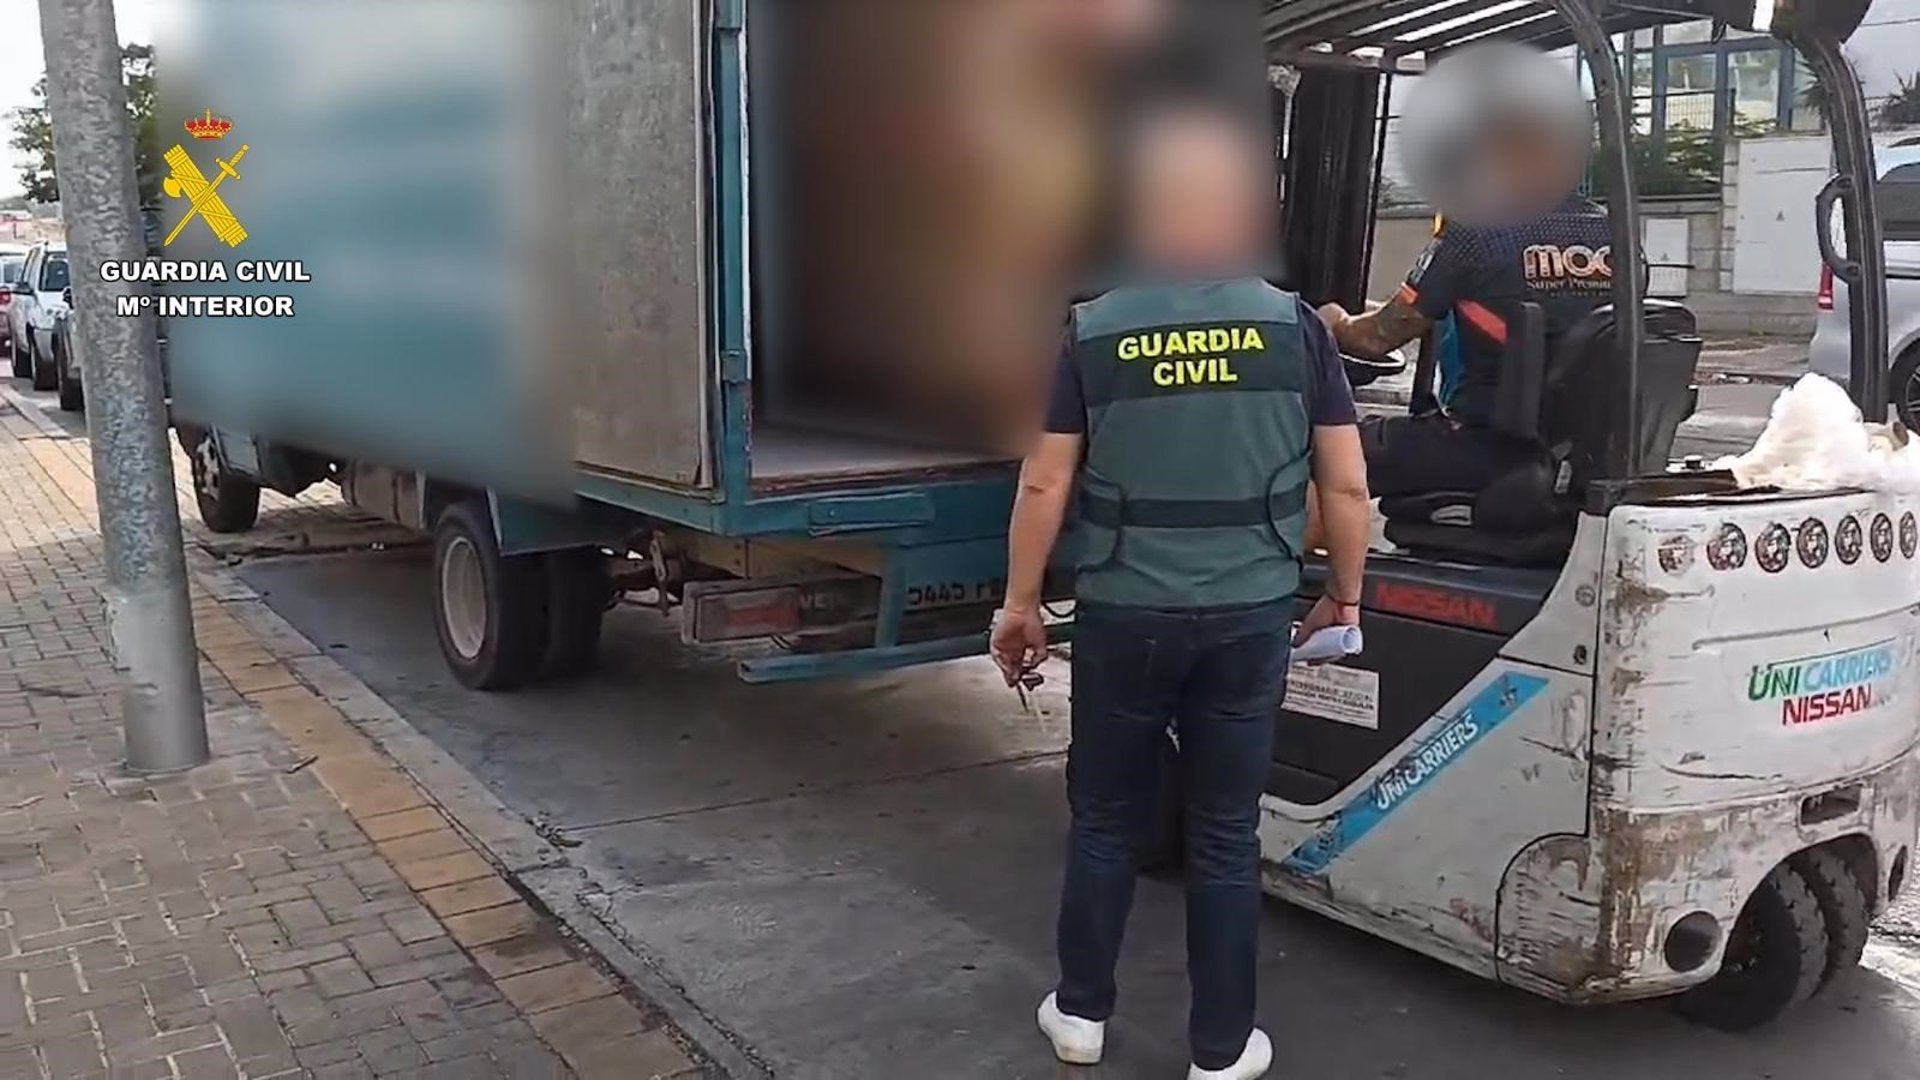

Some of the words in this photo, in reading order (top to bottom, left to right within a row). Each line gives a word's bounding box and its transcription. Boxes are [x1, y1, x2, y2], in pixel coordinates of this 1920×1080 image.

[1117, 327, 1265, 361] GUARDIA
[1152, 357, 1238, 386] CIVIL
[1377, 581, 1497, 627] NISSAN
[1781, 682, 1872, 725] NISSAN
